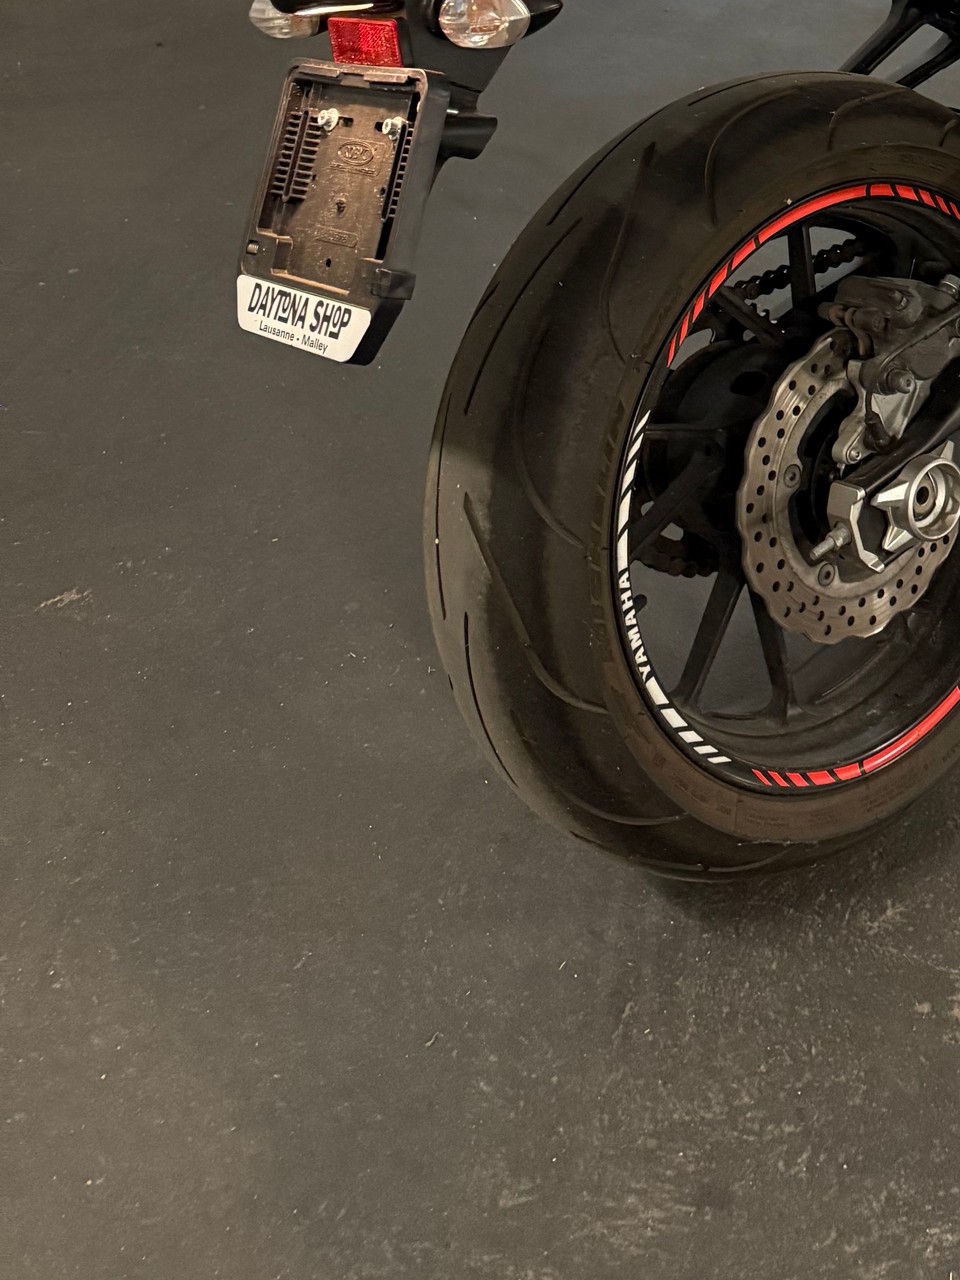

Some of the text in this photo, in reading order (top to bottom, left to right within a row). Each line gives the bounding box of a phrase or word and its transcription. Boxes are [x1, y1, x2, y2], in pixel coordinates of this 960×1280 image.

[247, 282, 352, 340] DAYTONA SHOP
[259, 320, 328, 354] Lausanne Malley
[618, 570, 652, 684] YAMAHA
